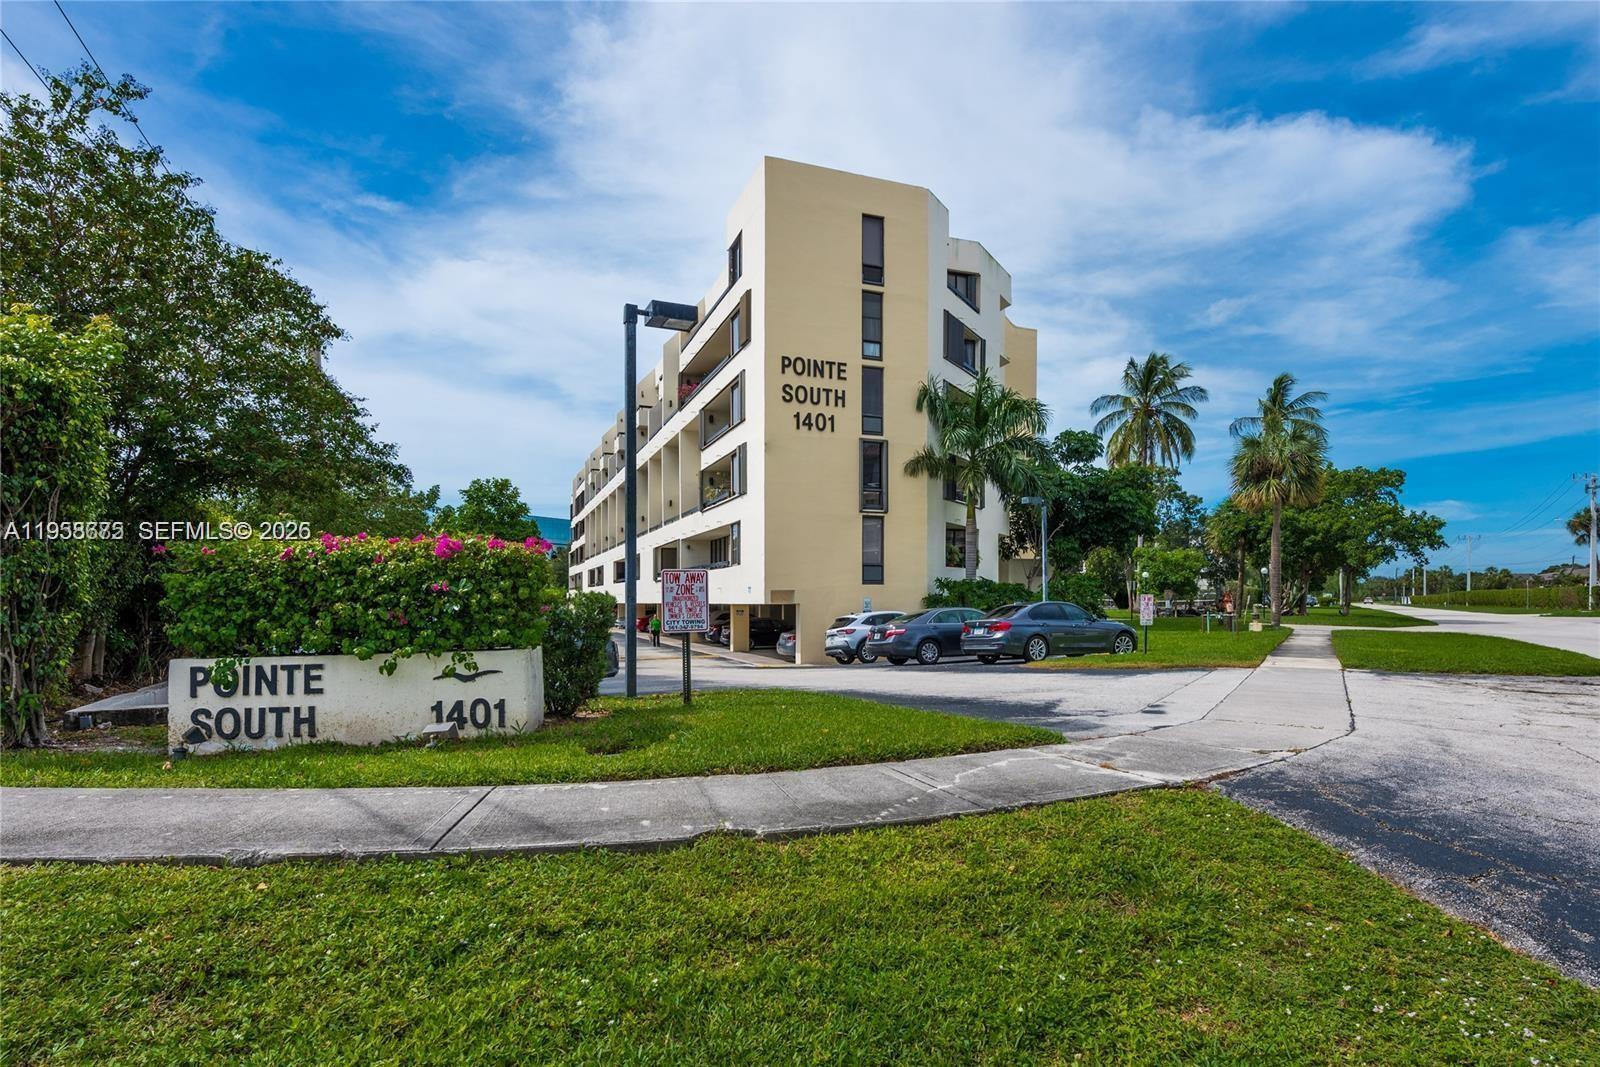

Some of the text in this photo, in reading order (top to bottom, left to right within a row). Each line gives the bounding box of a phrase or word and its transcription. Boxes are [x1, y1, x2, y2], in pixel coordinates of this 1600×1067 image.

[781, 356, 848, 381] POINTE
[781, 384, 846, 408] SOUTH
[793, 411, 835, 432] 1401
[664, 572, 705, 584] TOW AWAY
[676, 584, 695, 595] ZONE
[189, 663, 325, 698] POINTE
[190, 705, 317, 740] SOUTH
[430, 698, 507, 730] 1401
